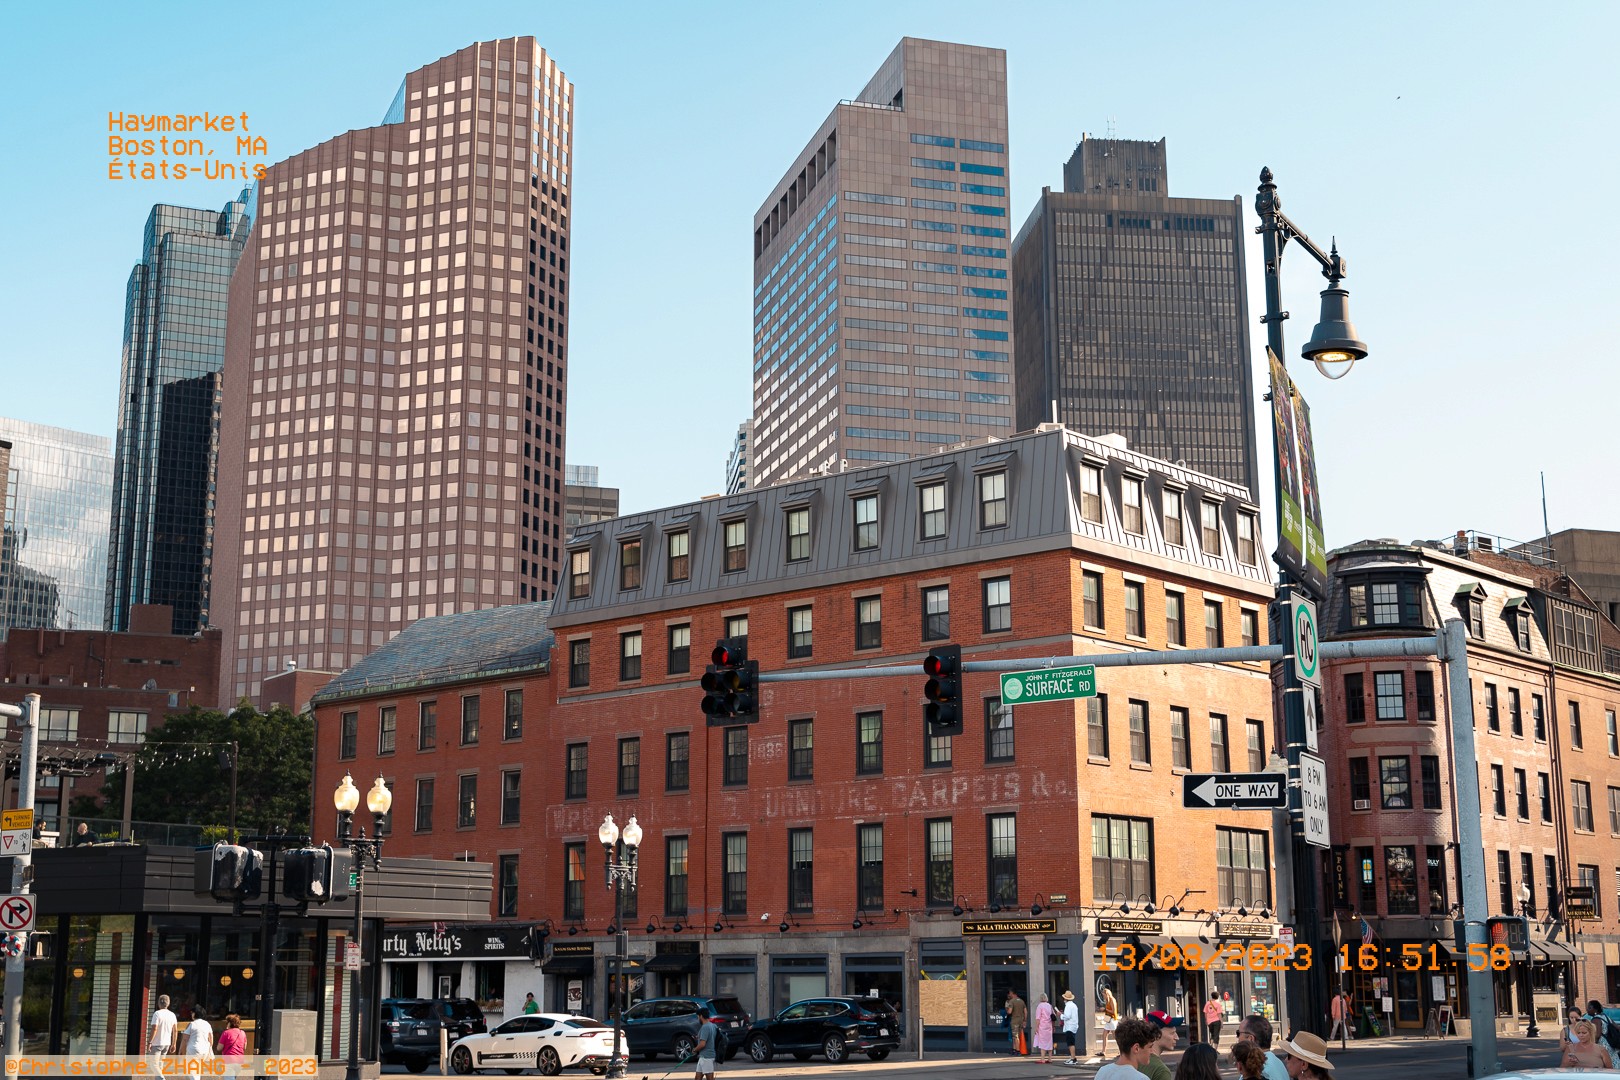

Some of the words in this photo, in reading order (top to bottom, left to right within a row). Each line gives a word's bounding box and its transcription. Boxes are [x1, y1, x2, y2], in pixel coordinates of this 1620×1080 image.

[1052, 669, 1092, 679] FITZGERALD
[1025, 678, 1075, 697] SURFACE
[1078, 680, 1091, 692] RD
[1307, 767, 1312, 782] 8
[1312, 769, 1321, 785] PM
[891, 771, 1021, 808] CARPETS
[1215, 784, 1241, 798] ONE
[1248, 783, 1277, 797] WAY
[1303, 790, 1312, 807] TO
[1313, 792, 1318, 809] 6
[1318, 795, 1327, 812] AM
[1310, 815, 1324, 836] ONLY
[1336, 856, 1344, 899] POINT
[994, 923, 1010, 931] THAI
[415, 931, 462, 956] Nelly's
[630, 976, 644, 990] OPEN
